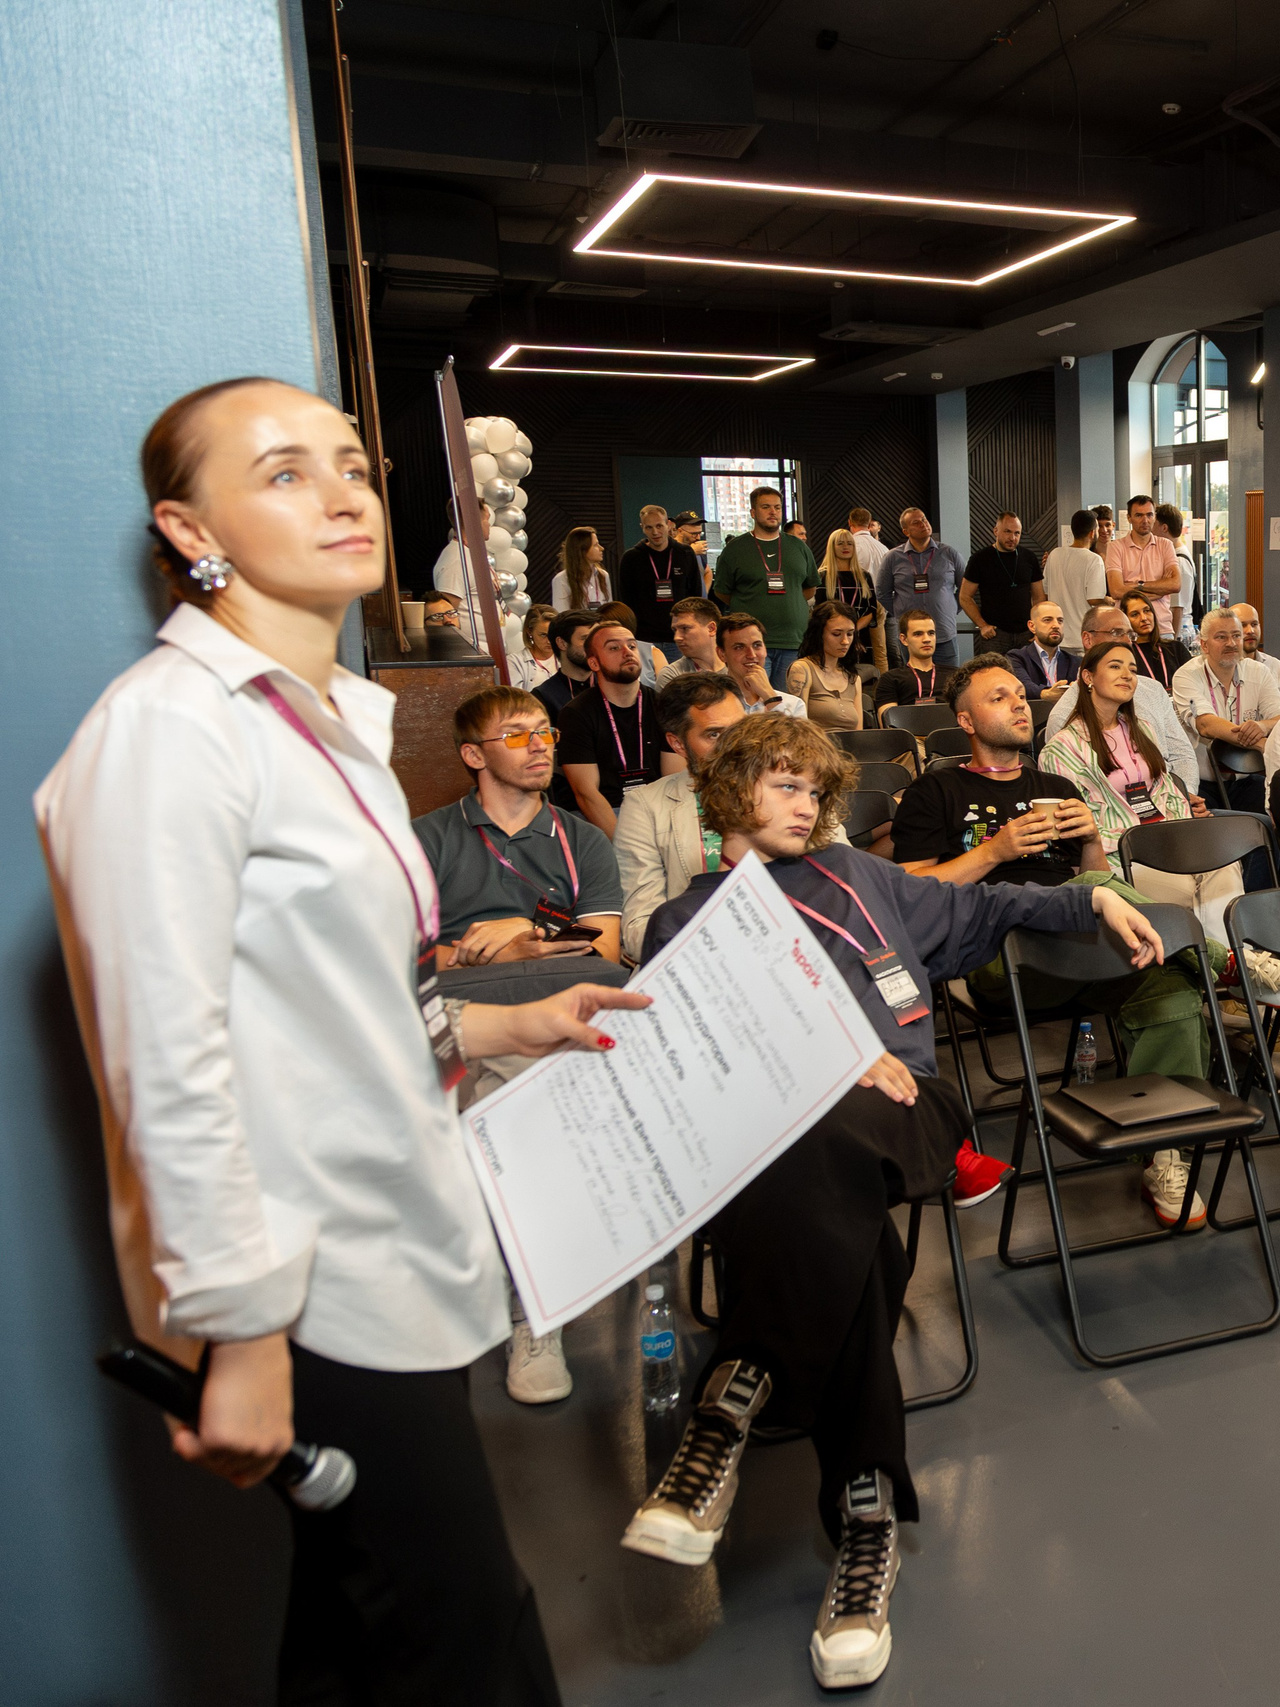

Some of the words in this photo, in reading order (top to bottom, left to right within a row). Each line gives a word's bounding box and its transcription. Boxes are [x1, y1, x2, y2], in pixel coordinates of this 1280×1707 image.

[699, 925, 718, 951] POV
[791, 943, 822, 989] spark
[664, 960, 697, 1012] Целевая
[693, 1011, 732, 1076] аудитория
[666, 1049, 686, 1082] боль
[474, 1116, 504, 1177] Прототип
[652, 1154, 686, 1218] продукта
